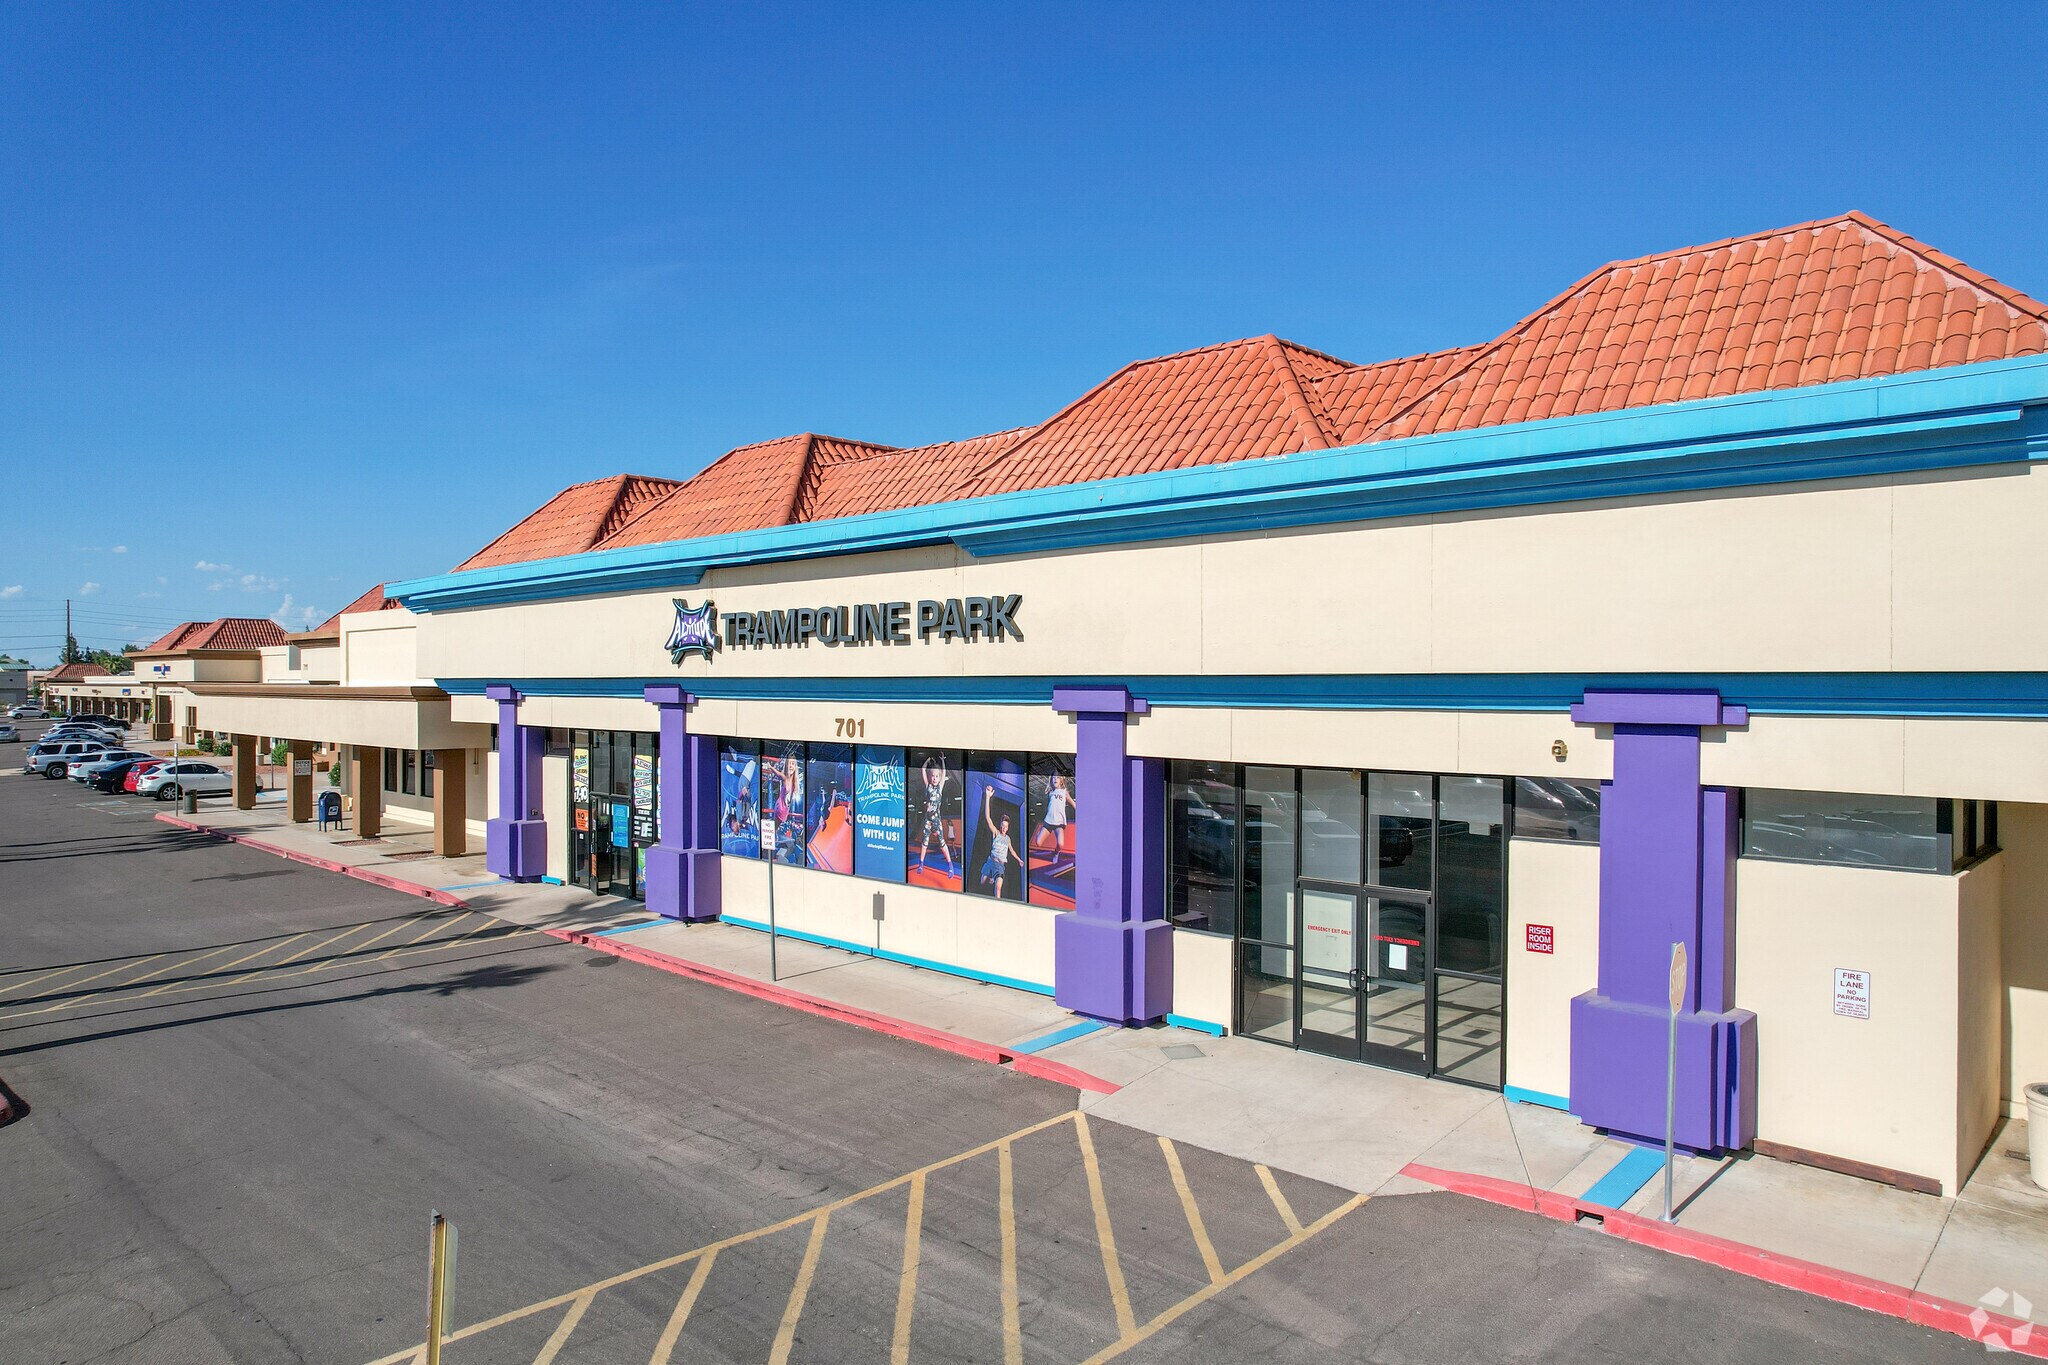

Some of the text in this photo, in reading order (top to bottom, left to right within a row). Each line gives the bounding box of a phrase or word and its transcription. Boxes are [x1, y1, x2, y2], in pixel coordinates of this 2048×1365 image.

[720, 594, 1023, 648] TRAMPOLINE PARK
[835, 718, 865, 738] 701
[858, 792, 890, 803] TRAMPOLINE
[857, 814, 905, 828] COME JUMP
[863, 828, 900, 842] WITH US!
[1307, 925, 1331, 933] EMERGENCY
[1529, 926, 1551, 935] RISER
[1528, 934, 1551, 943] ROOM
[1528, 942, 1552, 952] INSIDE
[1842, 972, 1862, 981] FIRE
[1840, 980, 1864, 989] LANE
[1837, 993, 1867, 1002] PARKING
